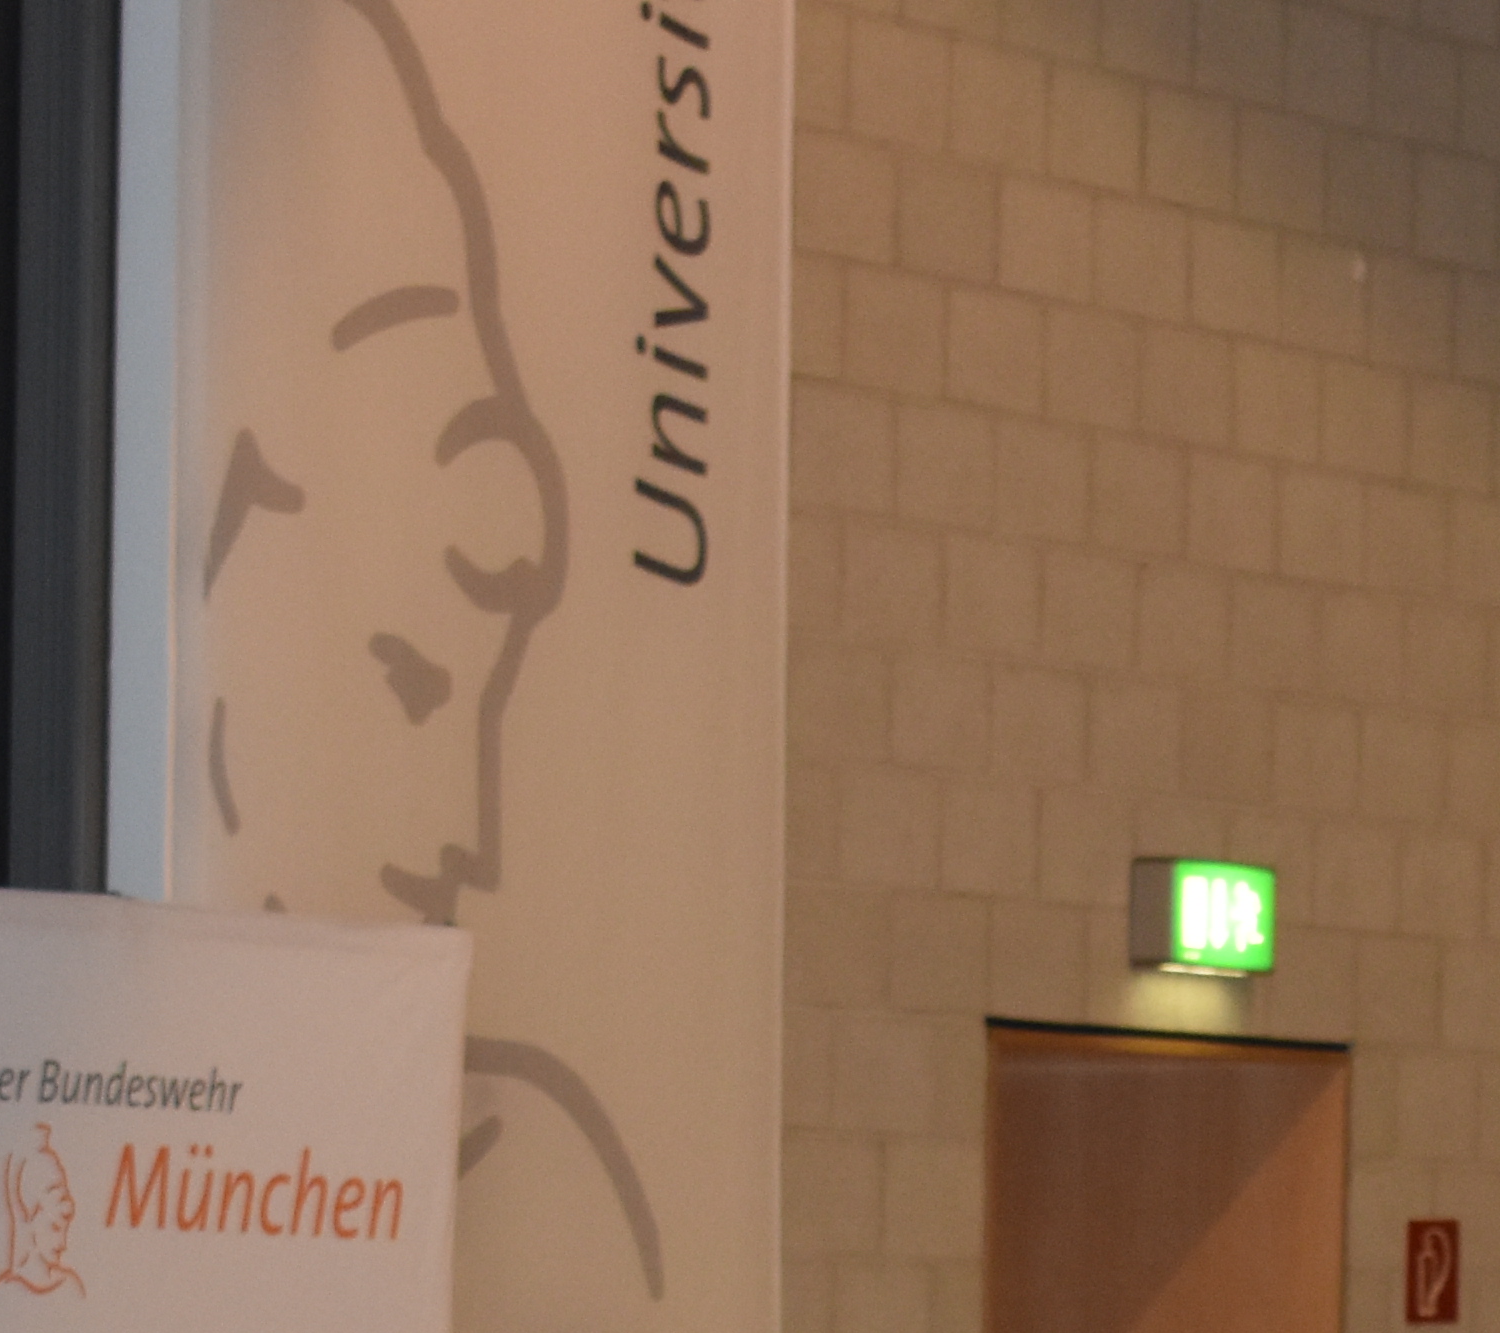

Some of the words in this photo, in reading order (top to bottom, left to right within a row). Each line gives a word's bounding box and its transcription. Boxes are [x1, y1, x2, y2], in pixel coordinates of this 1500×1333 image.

[634, 2, 710, 586] Universi
[37, 1058, 242, 1112] Bundeswehr
[105, 1143, 402, 1239] München
